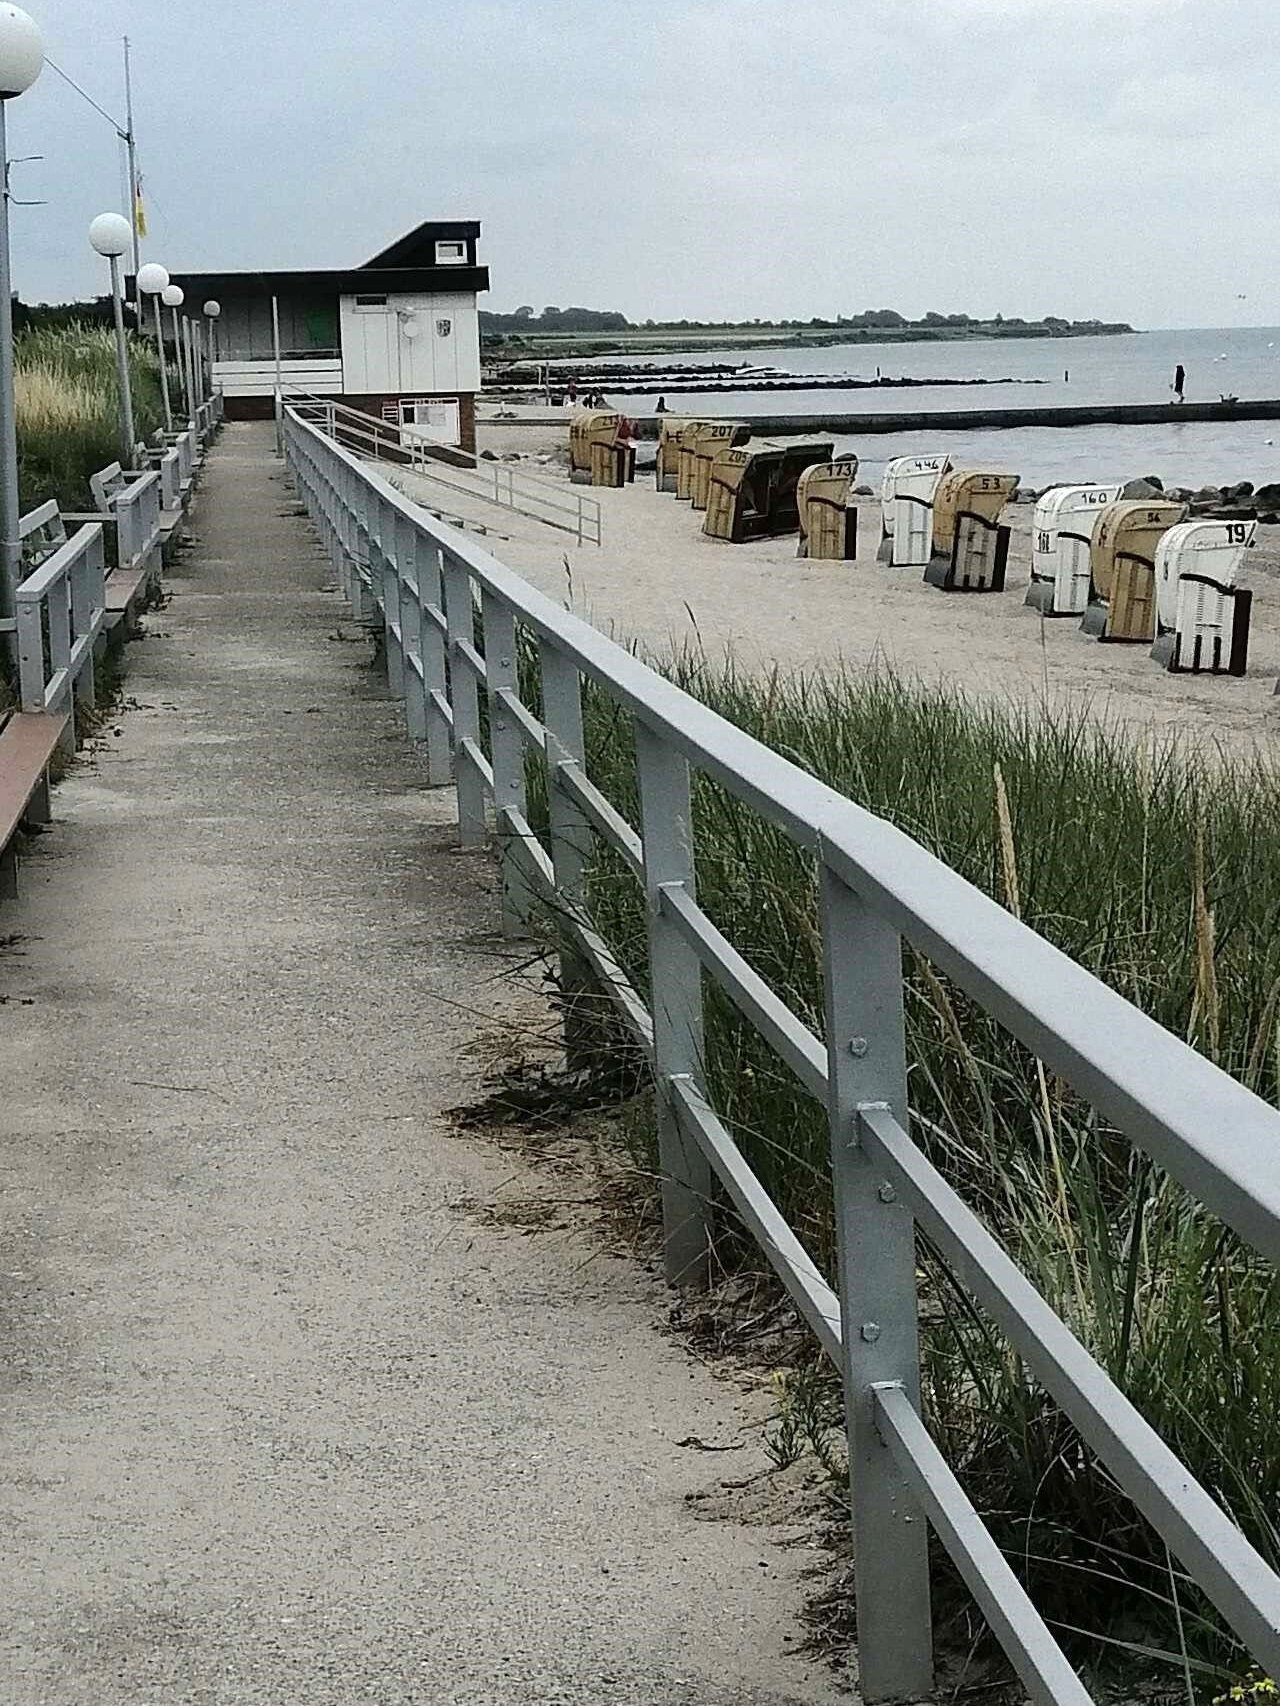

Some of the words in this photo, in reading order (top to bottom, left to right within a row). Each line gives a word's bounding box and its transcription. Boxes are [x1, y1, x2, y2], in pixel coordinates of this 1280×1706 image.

[711, 425, 733, 437] 207
[826, 462, 851, 477] 173
[982, 477, 1000, 490] 53
[1081, 492, 1107, 503] 160
[1225, 523, 1246, 544] 19
